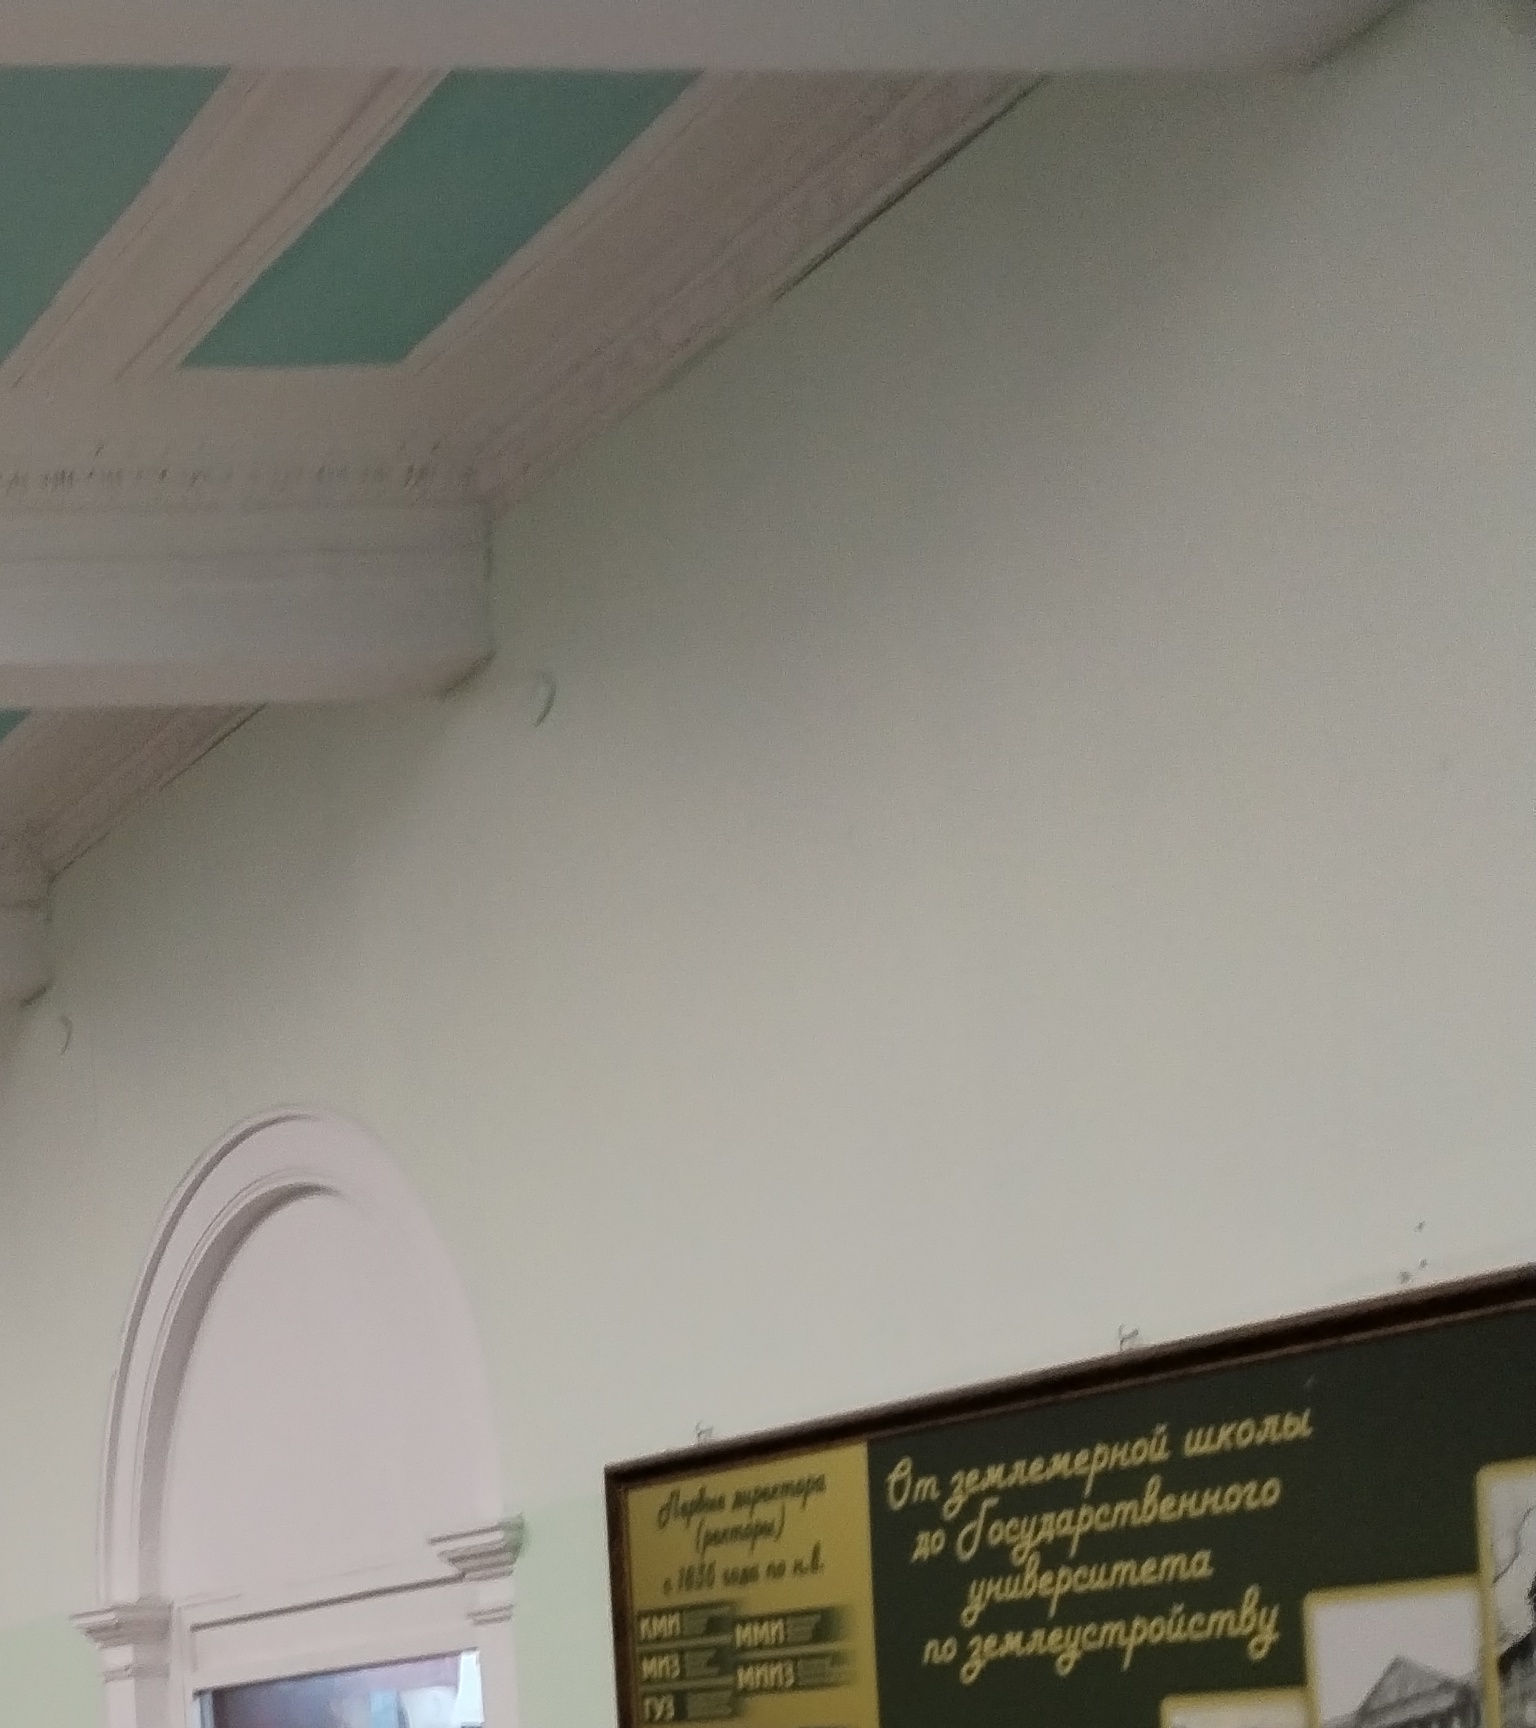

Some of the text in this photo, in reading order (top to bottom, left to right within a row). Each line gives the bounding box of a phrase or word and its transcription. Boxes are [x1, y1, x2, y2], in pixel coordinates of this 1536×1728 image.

[885, 1408, 1315, 1521] От землемерной школы
[912, 1474, 1283, 1567] до Государственного
[922, 1583, 1281, 1686] по землеустройству
[959, 1549, 1215, 1628] университета
